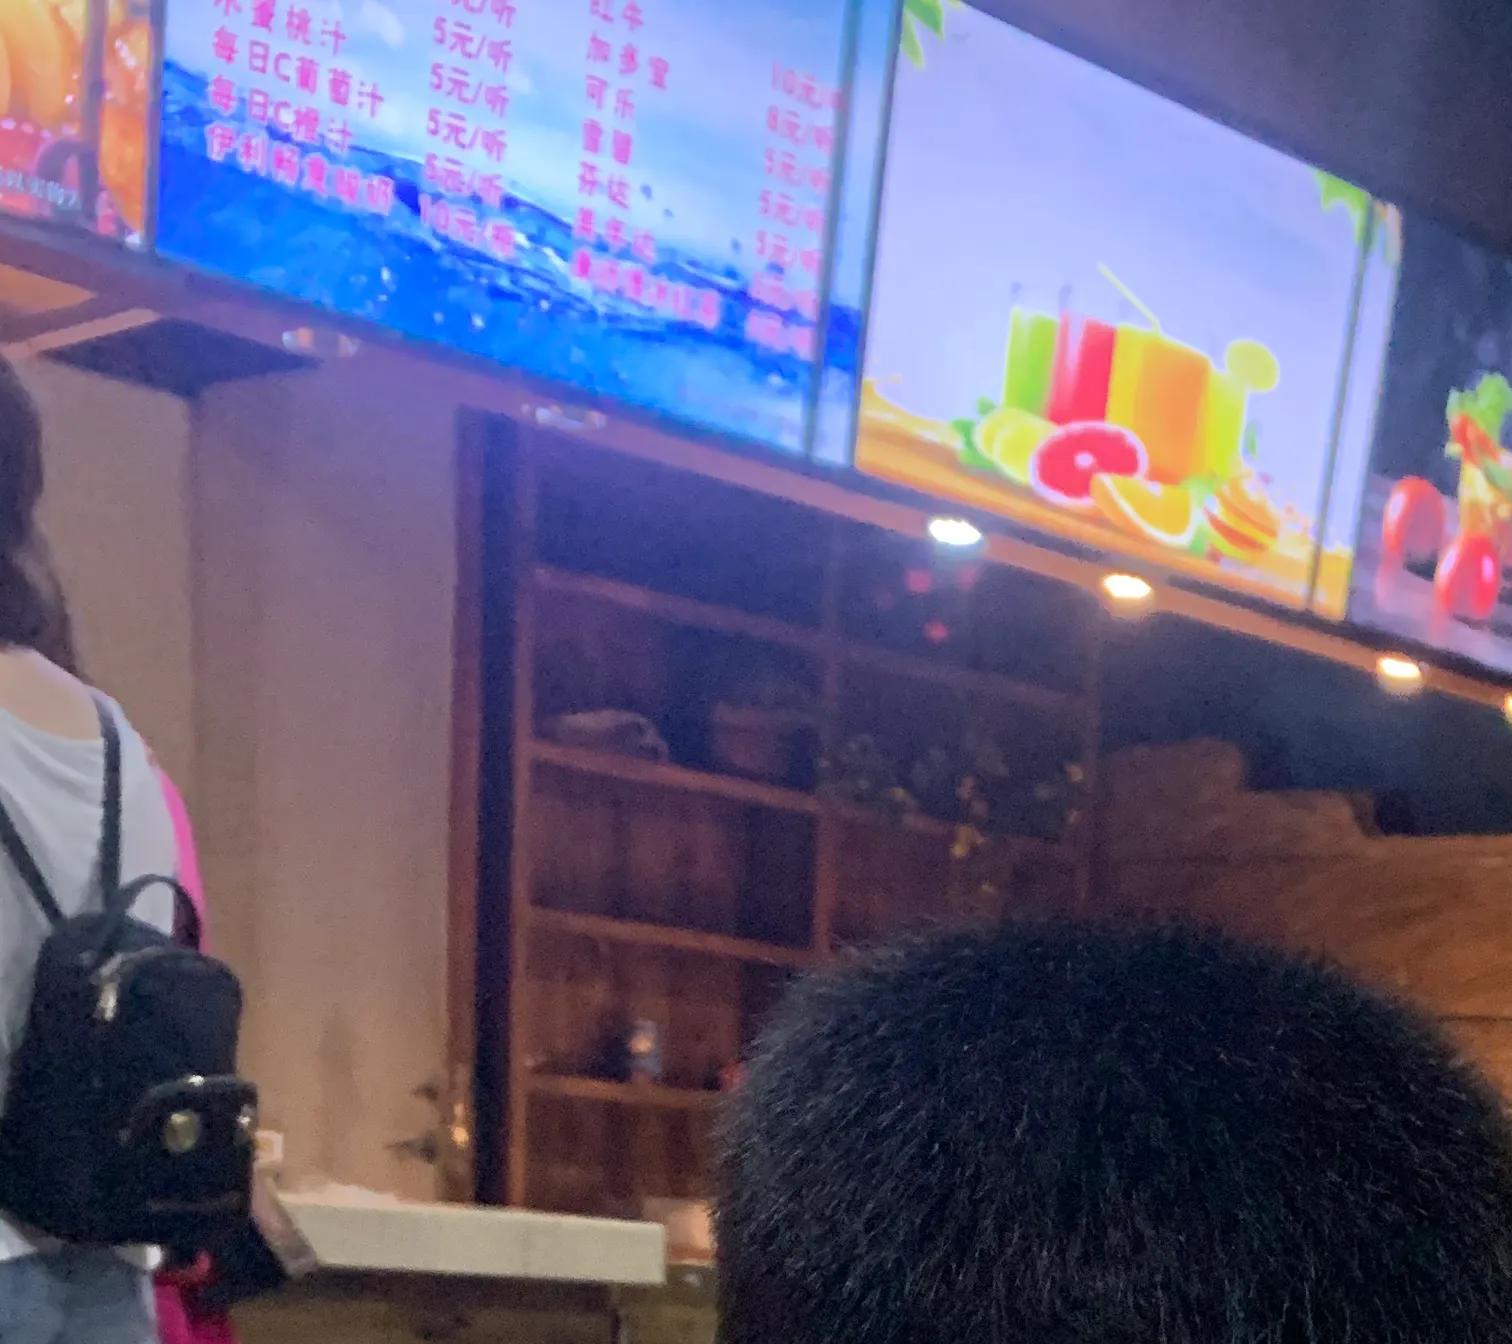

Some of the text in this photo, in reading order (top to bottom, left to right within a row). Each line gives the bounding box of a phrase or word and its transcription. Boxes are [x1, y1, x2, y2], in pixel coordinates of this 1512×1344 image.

[433, 15, 512, 72] 5元/听
[213, 26, 507, 163] 每日C葡萄汁 5元/听
[430, 62, 509, 118] 5元/听
[585, 74, 635, 119] 可乐
[423, 153, 503, 209] 5元/听
